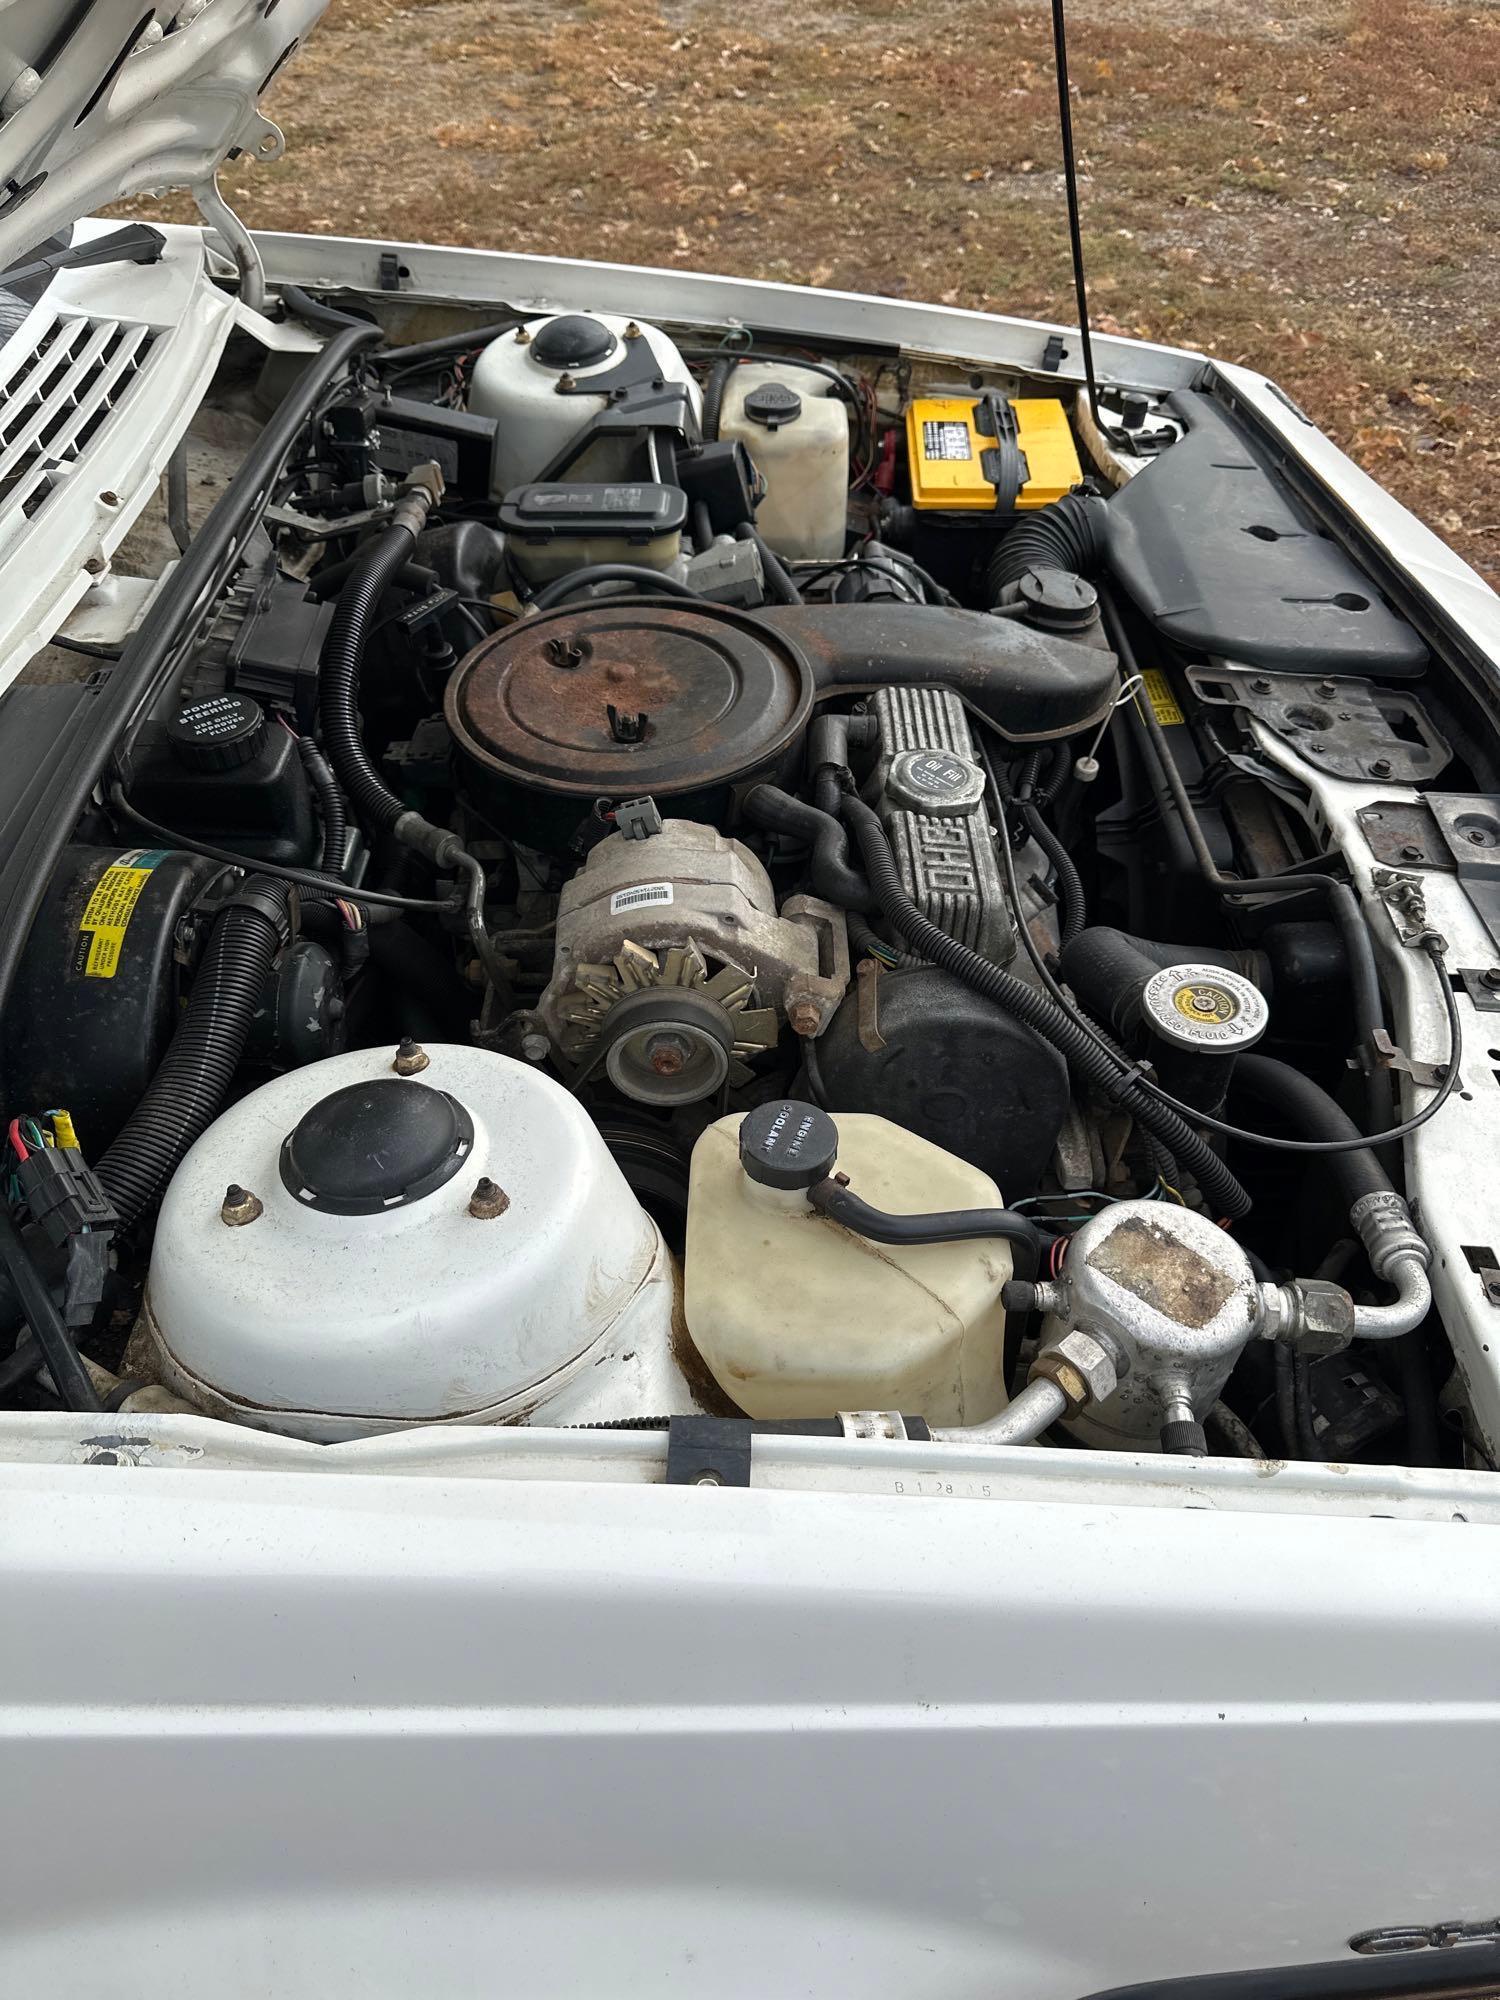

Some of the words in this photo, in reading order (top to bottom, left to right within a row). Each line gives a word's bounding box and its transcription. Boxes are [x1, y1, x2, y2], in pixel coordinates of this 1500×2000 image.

[179, 701, 242, 724] STEERING
[182, 697, 229, 715] POWER
[194, 721, 212, 730] USE
[214, 713, 238, 722] ONLY
[196, 716, 245, 735] APPROVED
[210, 724, 237, 736] FLUID
[925, 760, 942, 771] Oil
[943, 770, 962, 781] Fill
[76, 935, 88, 971] CAUTION
[93, 938, 104, 970] REFRIGERANT
[1198, 989, 1229, 1015] CAUTION
[1188, 1029, 1229, 1040] FLUID
[761, 1104, 792, 1152] COOLANT
